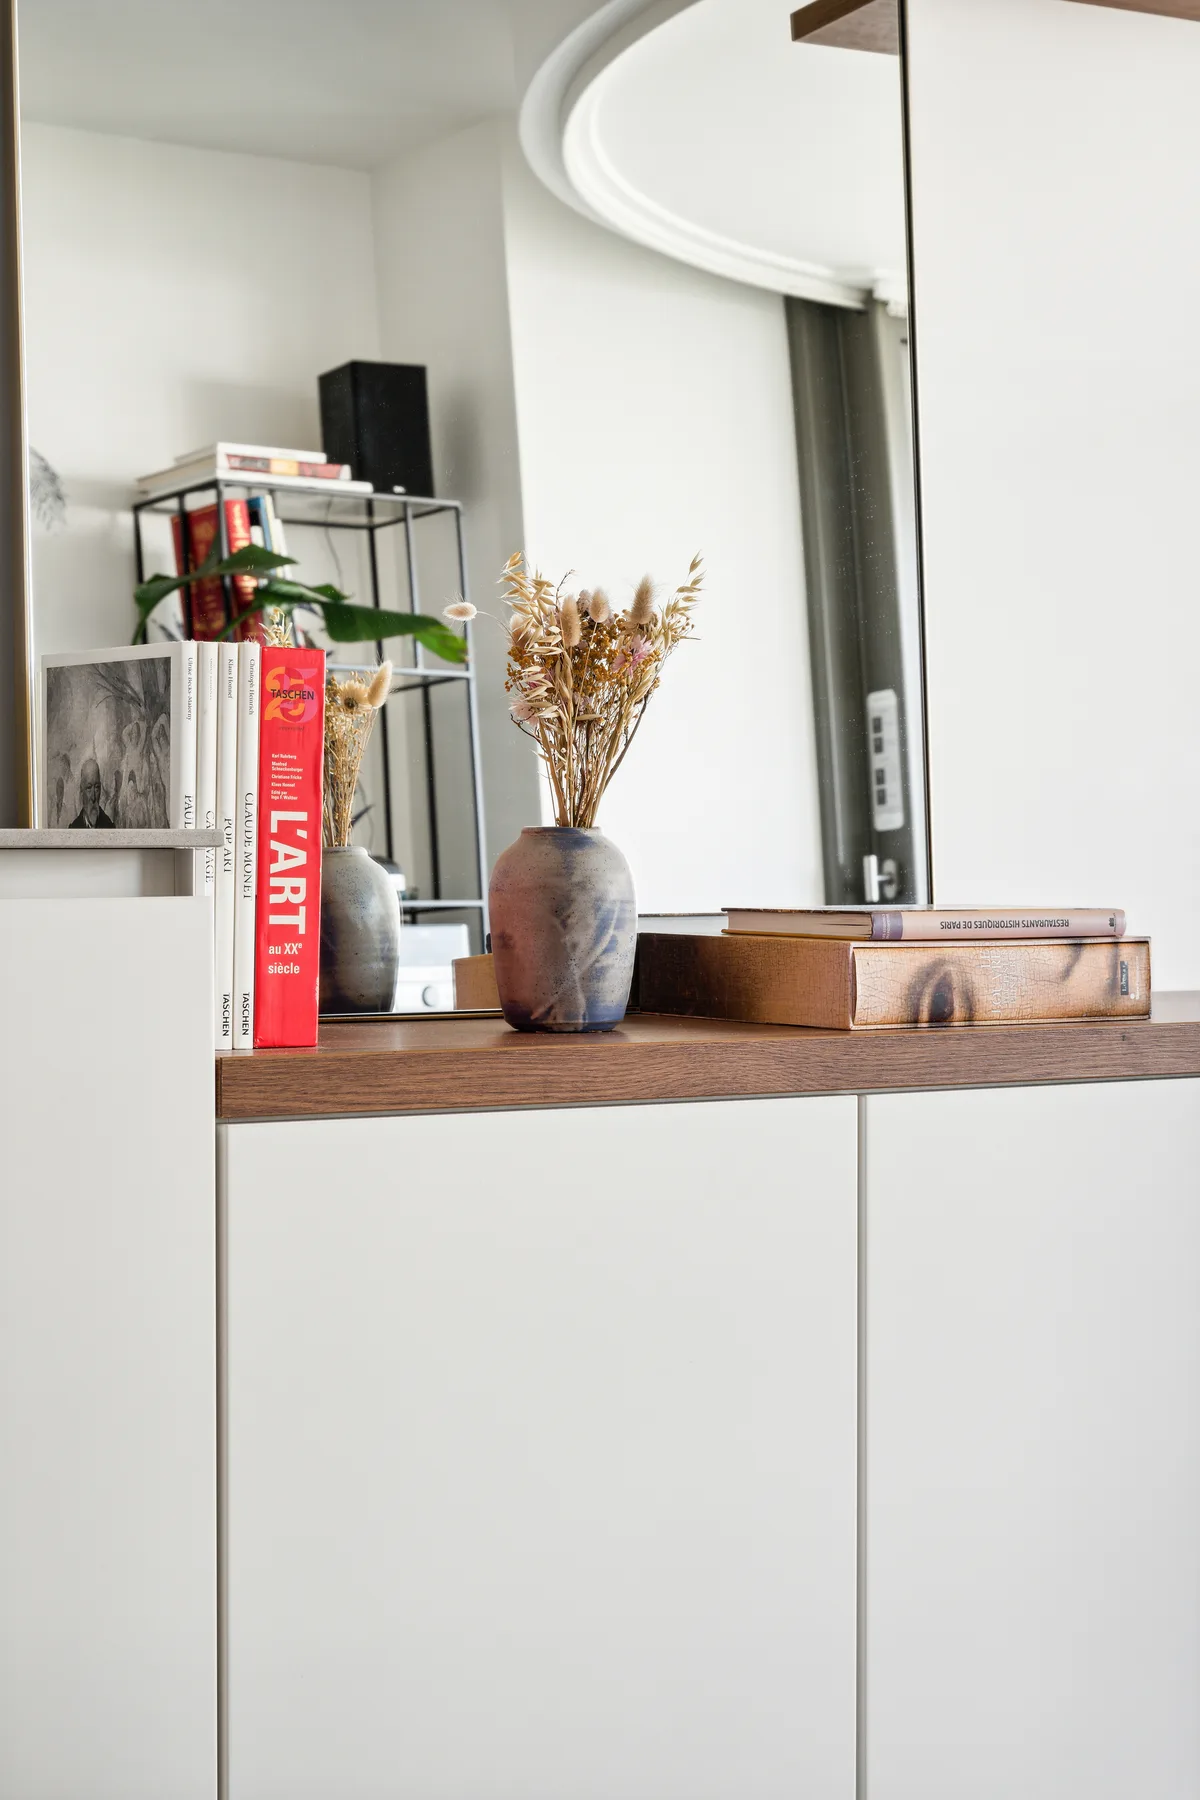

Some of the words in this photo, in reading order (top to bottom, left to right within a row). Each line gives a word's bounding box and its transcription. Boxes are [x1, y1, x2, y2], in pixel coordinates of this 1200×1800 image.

[271, 689, 314, 700] TASCHEN
[185, 795, 193, 828] PAUL
[244, 792, 254, 847] CLAUDE
[224, 818, 233, 844] POP
[223, 848, 233, 875] ART
[268, 811, 308, 935] L'ART
[243, 851, 253, 901] MONET
[940, 921, 961, 930] PARIS
[962, 921, 973, 929] DE
[974, 919, 1020, 929] HISTORIQUES
[1020, 919, 1069, 928] RESTAURANTS
[268, 944, 281, 955] au
[268, 962, 300, 975] siècle
[222, 993, 230, 1037] TASCHEN
[241, 992, 250, 1036] TASCHEN
